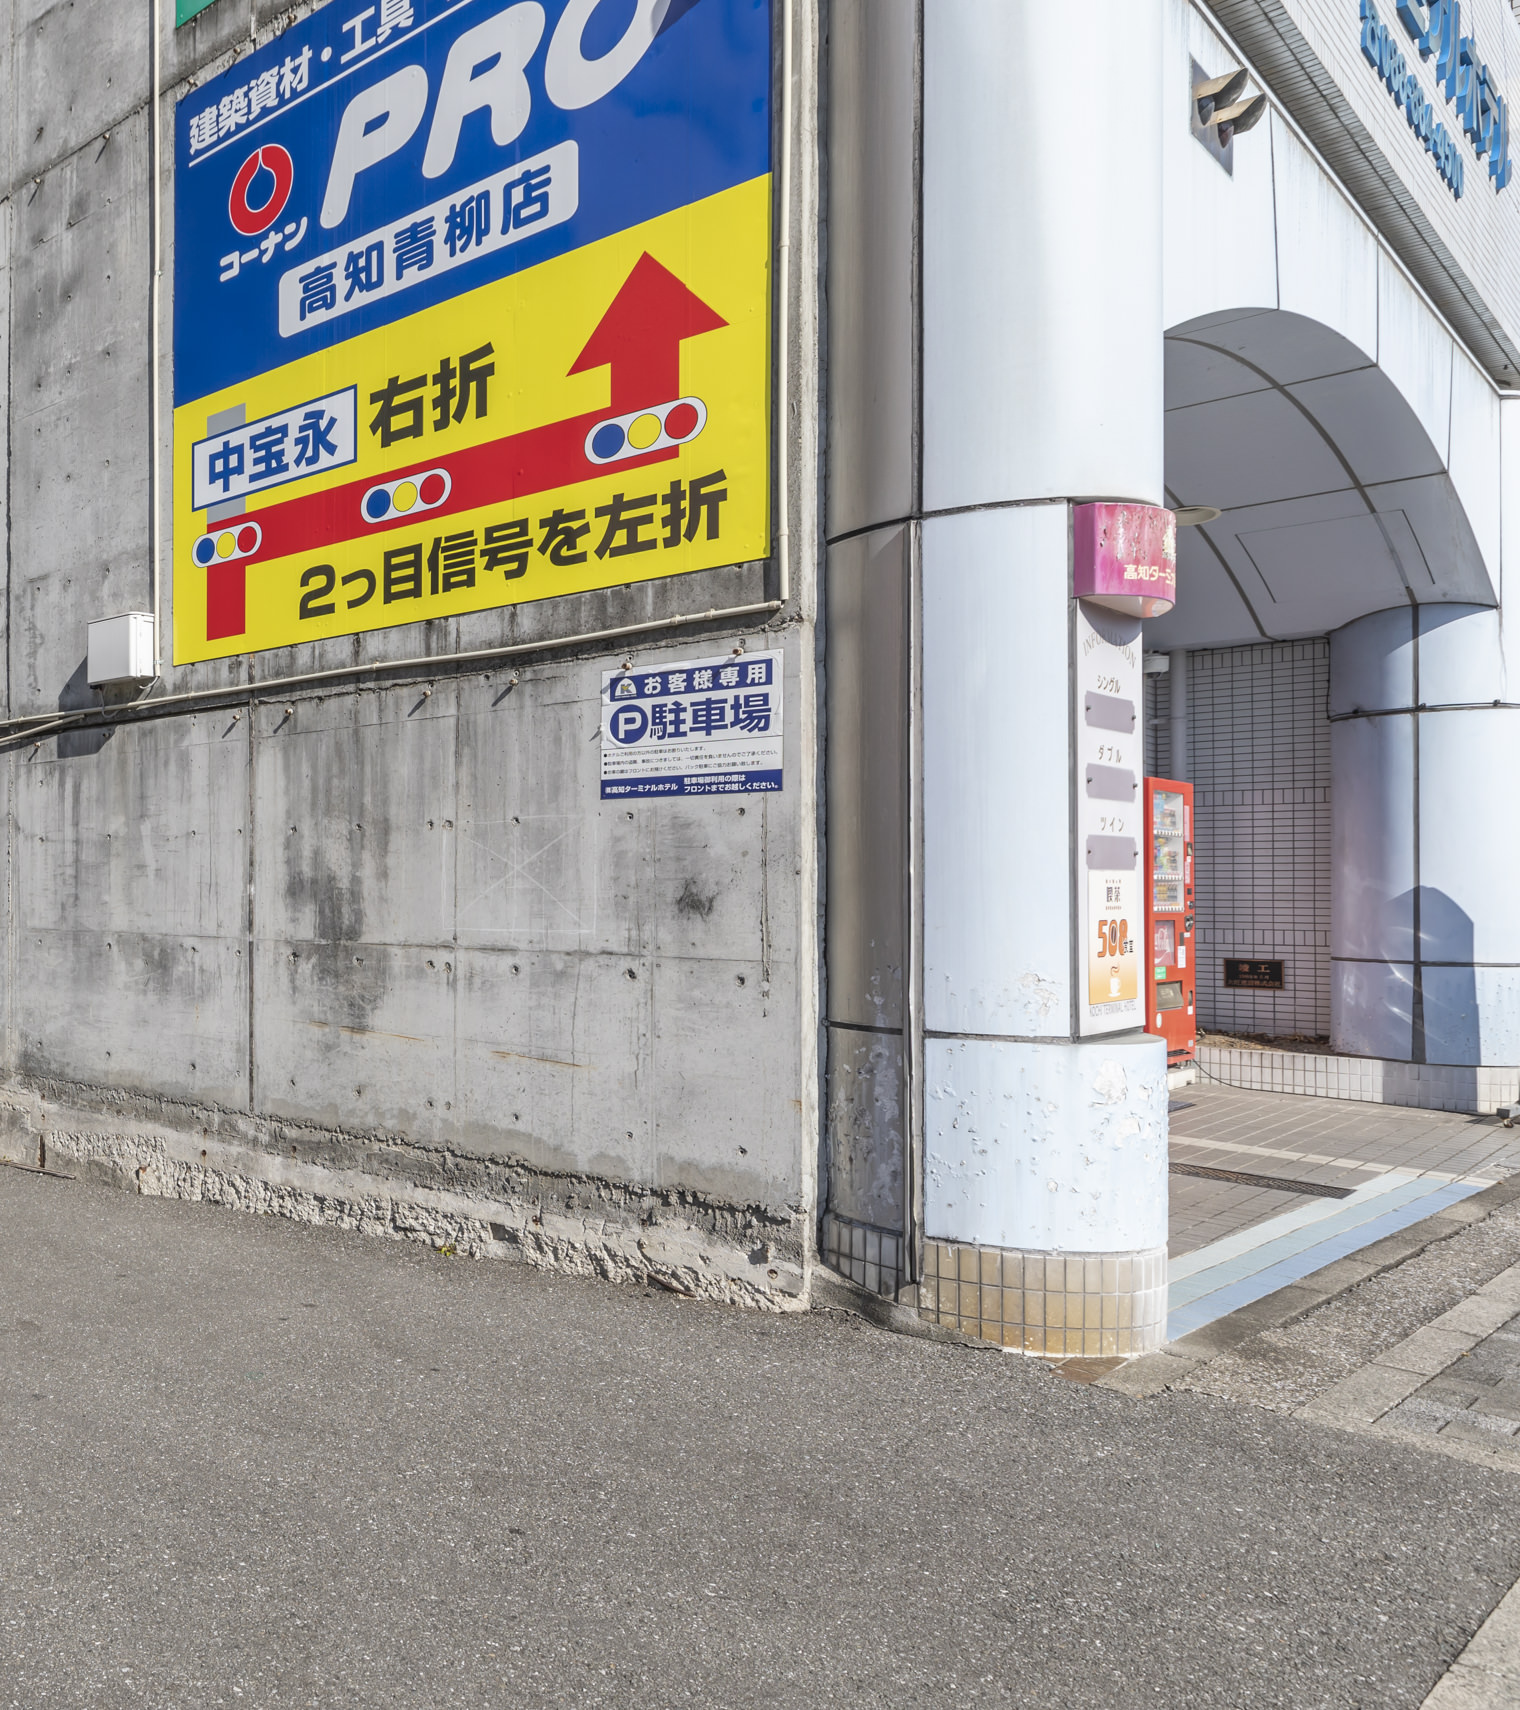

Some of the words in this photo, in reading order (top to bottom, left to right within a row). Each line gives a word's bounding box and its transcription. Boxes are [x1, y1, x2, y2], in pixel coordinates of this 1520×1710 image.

[319, 0, 672, 229] PRO
[219, 215, 309, 283] コーナン
[298, 165, 553, 322] 高知青柳店
[207, 410, 340, 493] 中宝永
[368, 342, 496, 449] 右折
[298, 469, 729, 621] 2つ目信号を左折
[643, 662, 768, 695] お客様専用
[1097, 674, 1121, 694] シングル
[649, 692, 772, 741] 駐車場
[1098, 744, 1122, 763] ダブル
[684, 781, 779, 793] フロントまでお越しください。
[1100, 816, 1125, 832] ツイン
